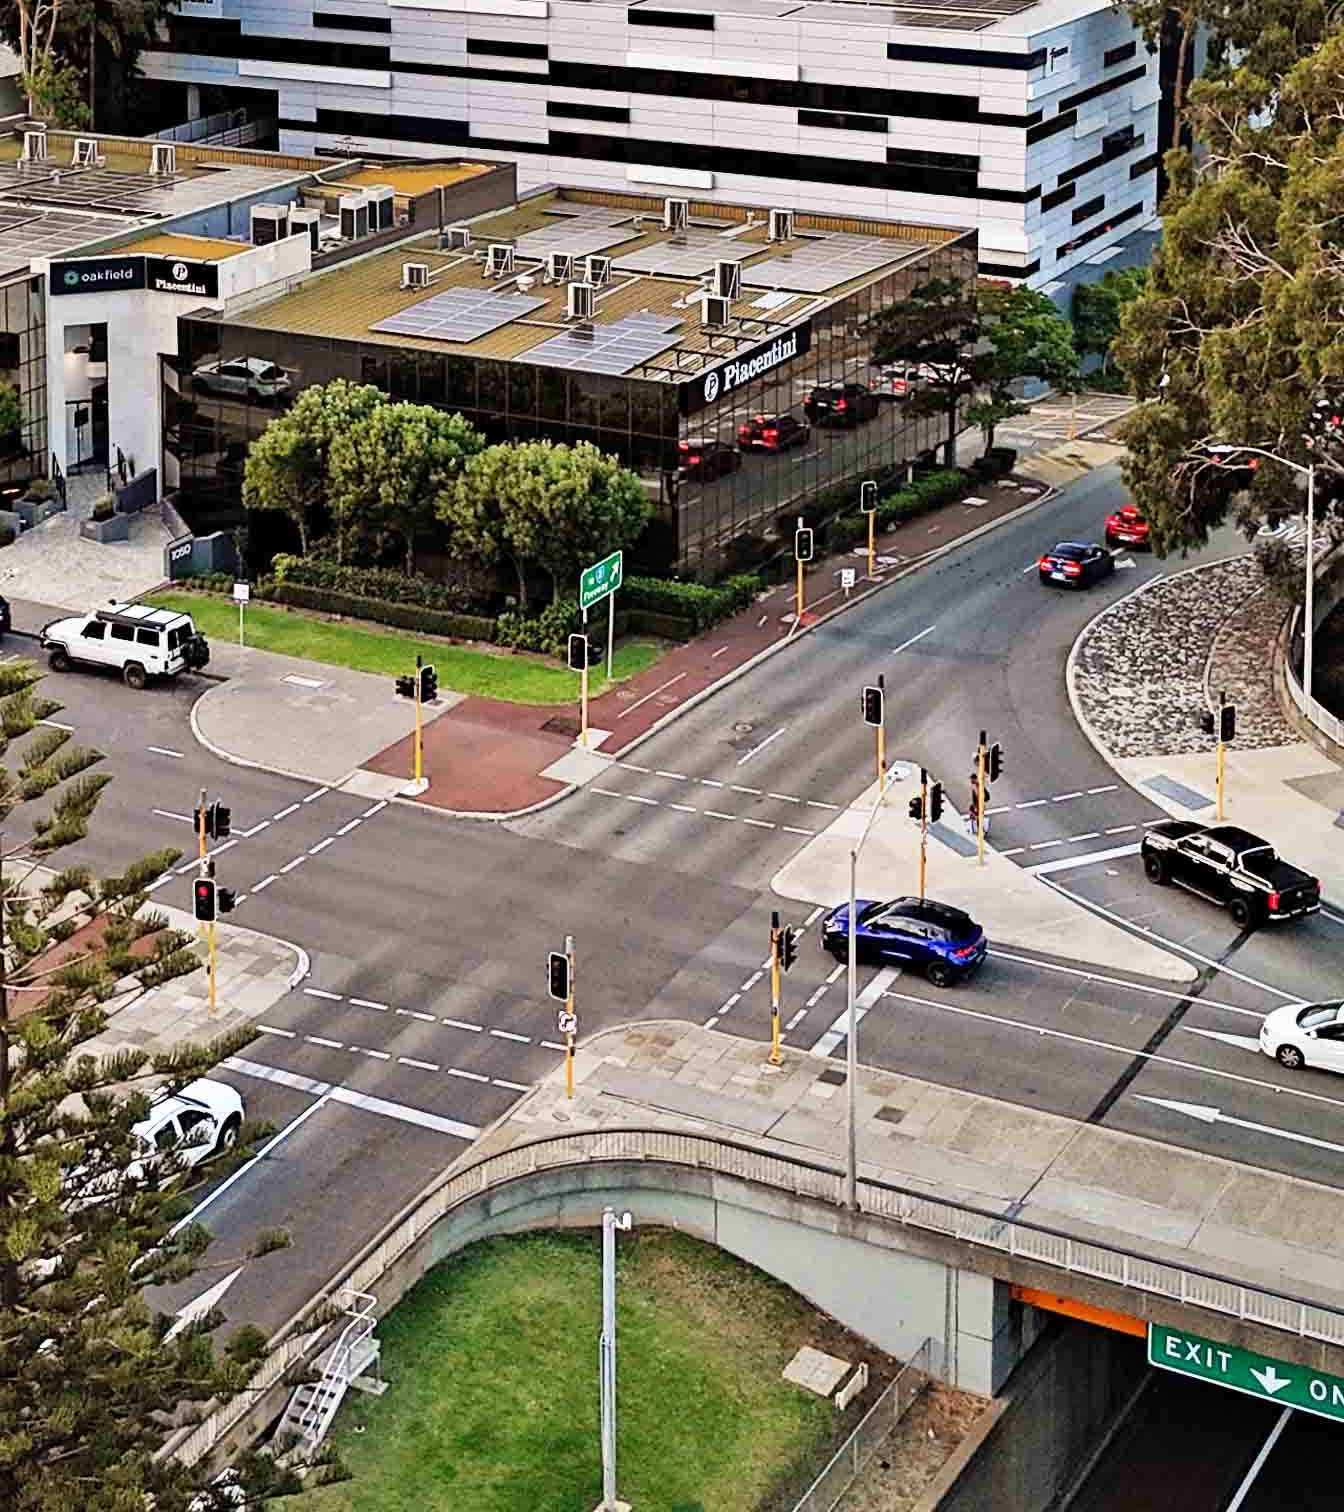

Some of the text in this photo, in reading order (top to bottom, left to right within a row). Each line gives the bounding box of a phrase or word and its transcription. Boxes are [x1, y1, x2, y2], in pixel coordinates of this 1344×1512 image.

[81, 268, 133, 282] oakfield
[155, 278, 207, 294] Piacentini
[723, 331, 797, 392] Piacentini
[171, 544, 191, 560] 1050
[1165, 1335, 1233, 1373] EXIT
